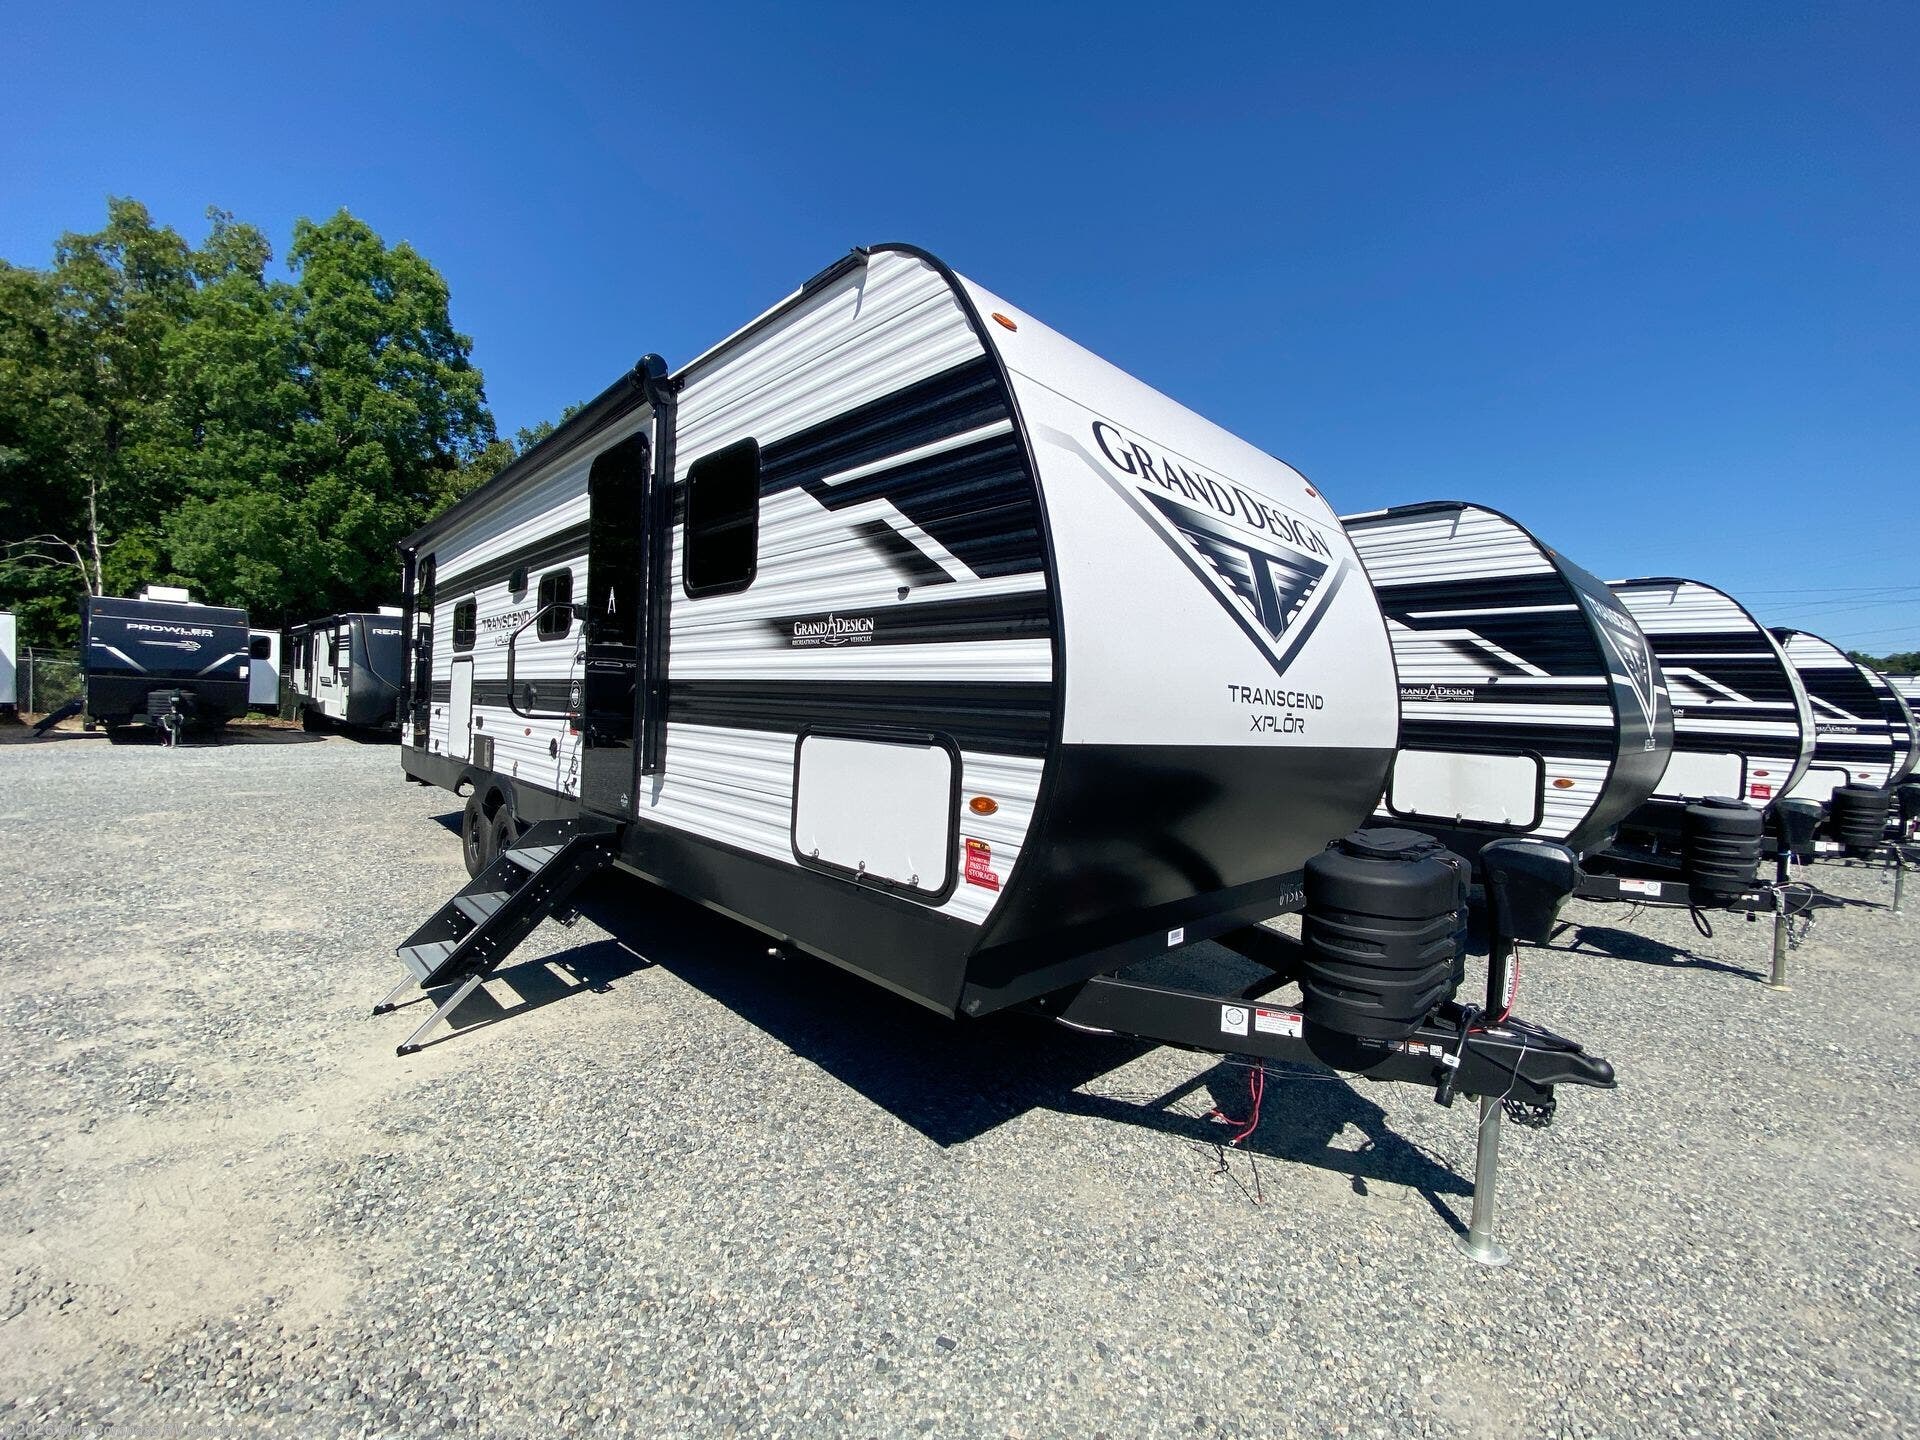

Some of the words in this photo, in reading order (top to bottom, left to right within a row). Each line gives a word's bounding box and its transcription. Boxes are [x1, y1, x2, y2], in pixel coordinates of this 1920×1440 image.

[1092, 420, 1236, 517] GRAND
[1230, 485, 1333, 560] DESIGN
[126, 623, 214, 636] PROWLER
[793, 621, 828, 636] GRAND
[836, 617, 874, 633] DESIGN
[1227, 684, 1324, 710] TRANSCEND
[1437, 686, 1475, 695] DESIGN
[968, 869, 997, 881] STORAGE
